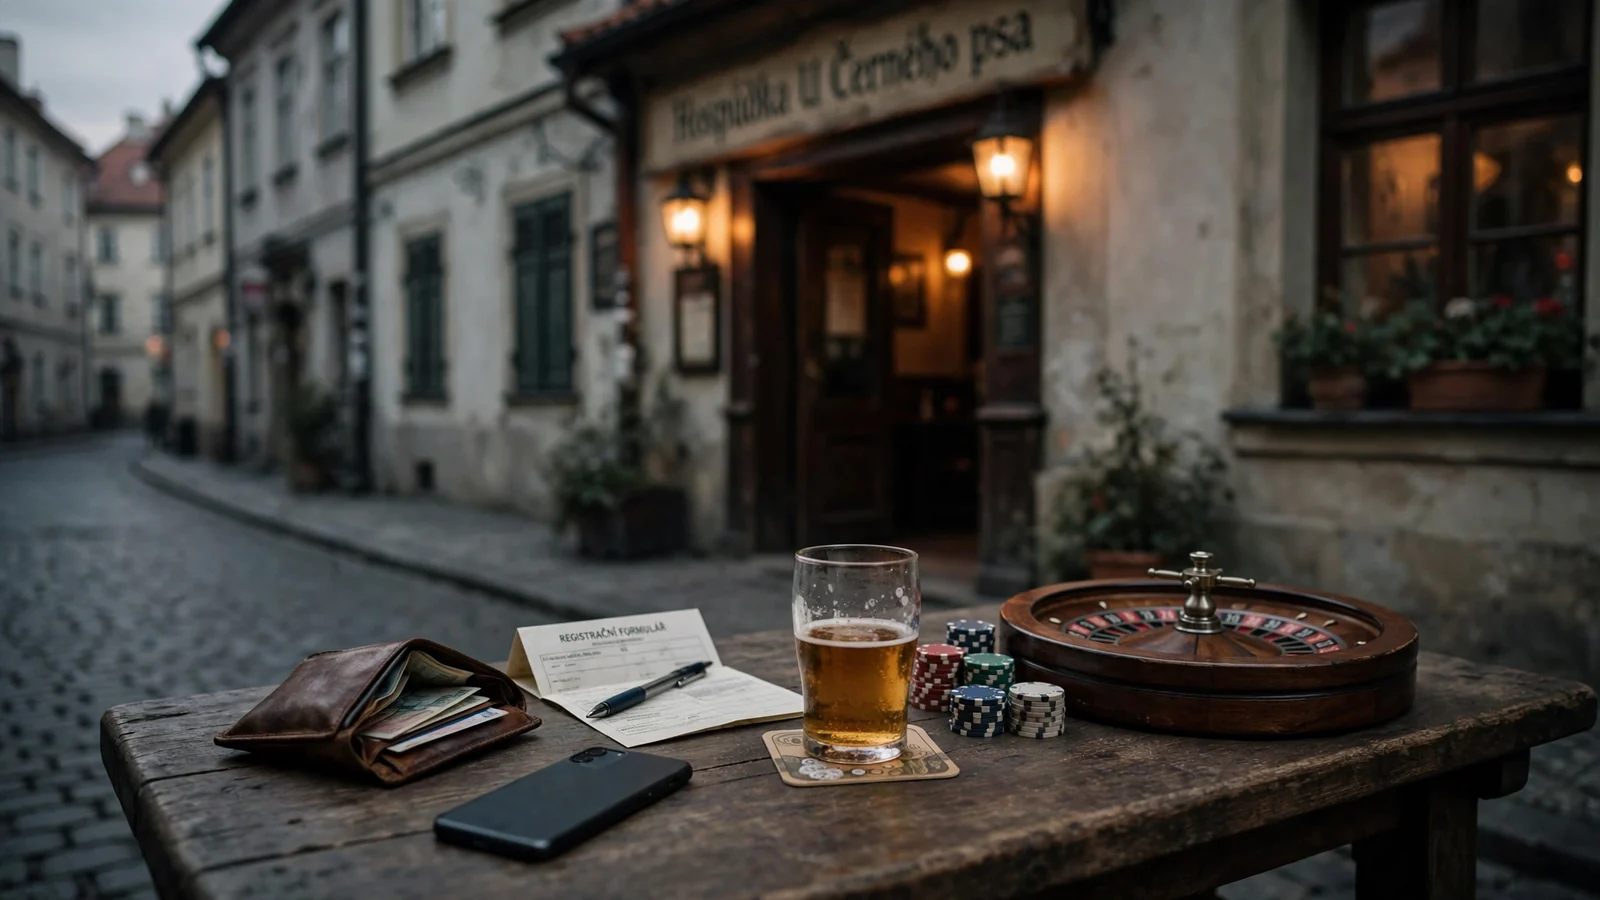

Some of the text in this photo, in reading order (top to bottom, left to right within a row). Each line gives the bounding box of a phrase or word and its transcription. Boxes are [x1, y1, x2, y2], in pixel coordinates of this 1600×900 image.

[798, 57, 822, 107] U
[830, 22, 960, 98] Černého
[969, 11, 1033, 79] psa
[559, 625, 617, 643] REGISTRAČNÍ
